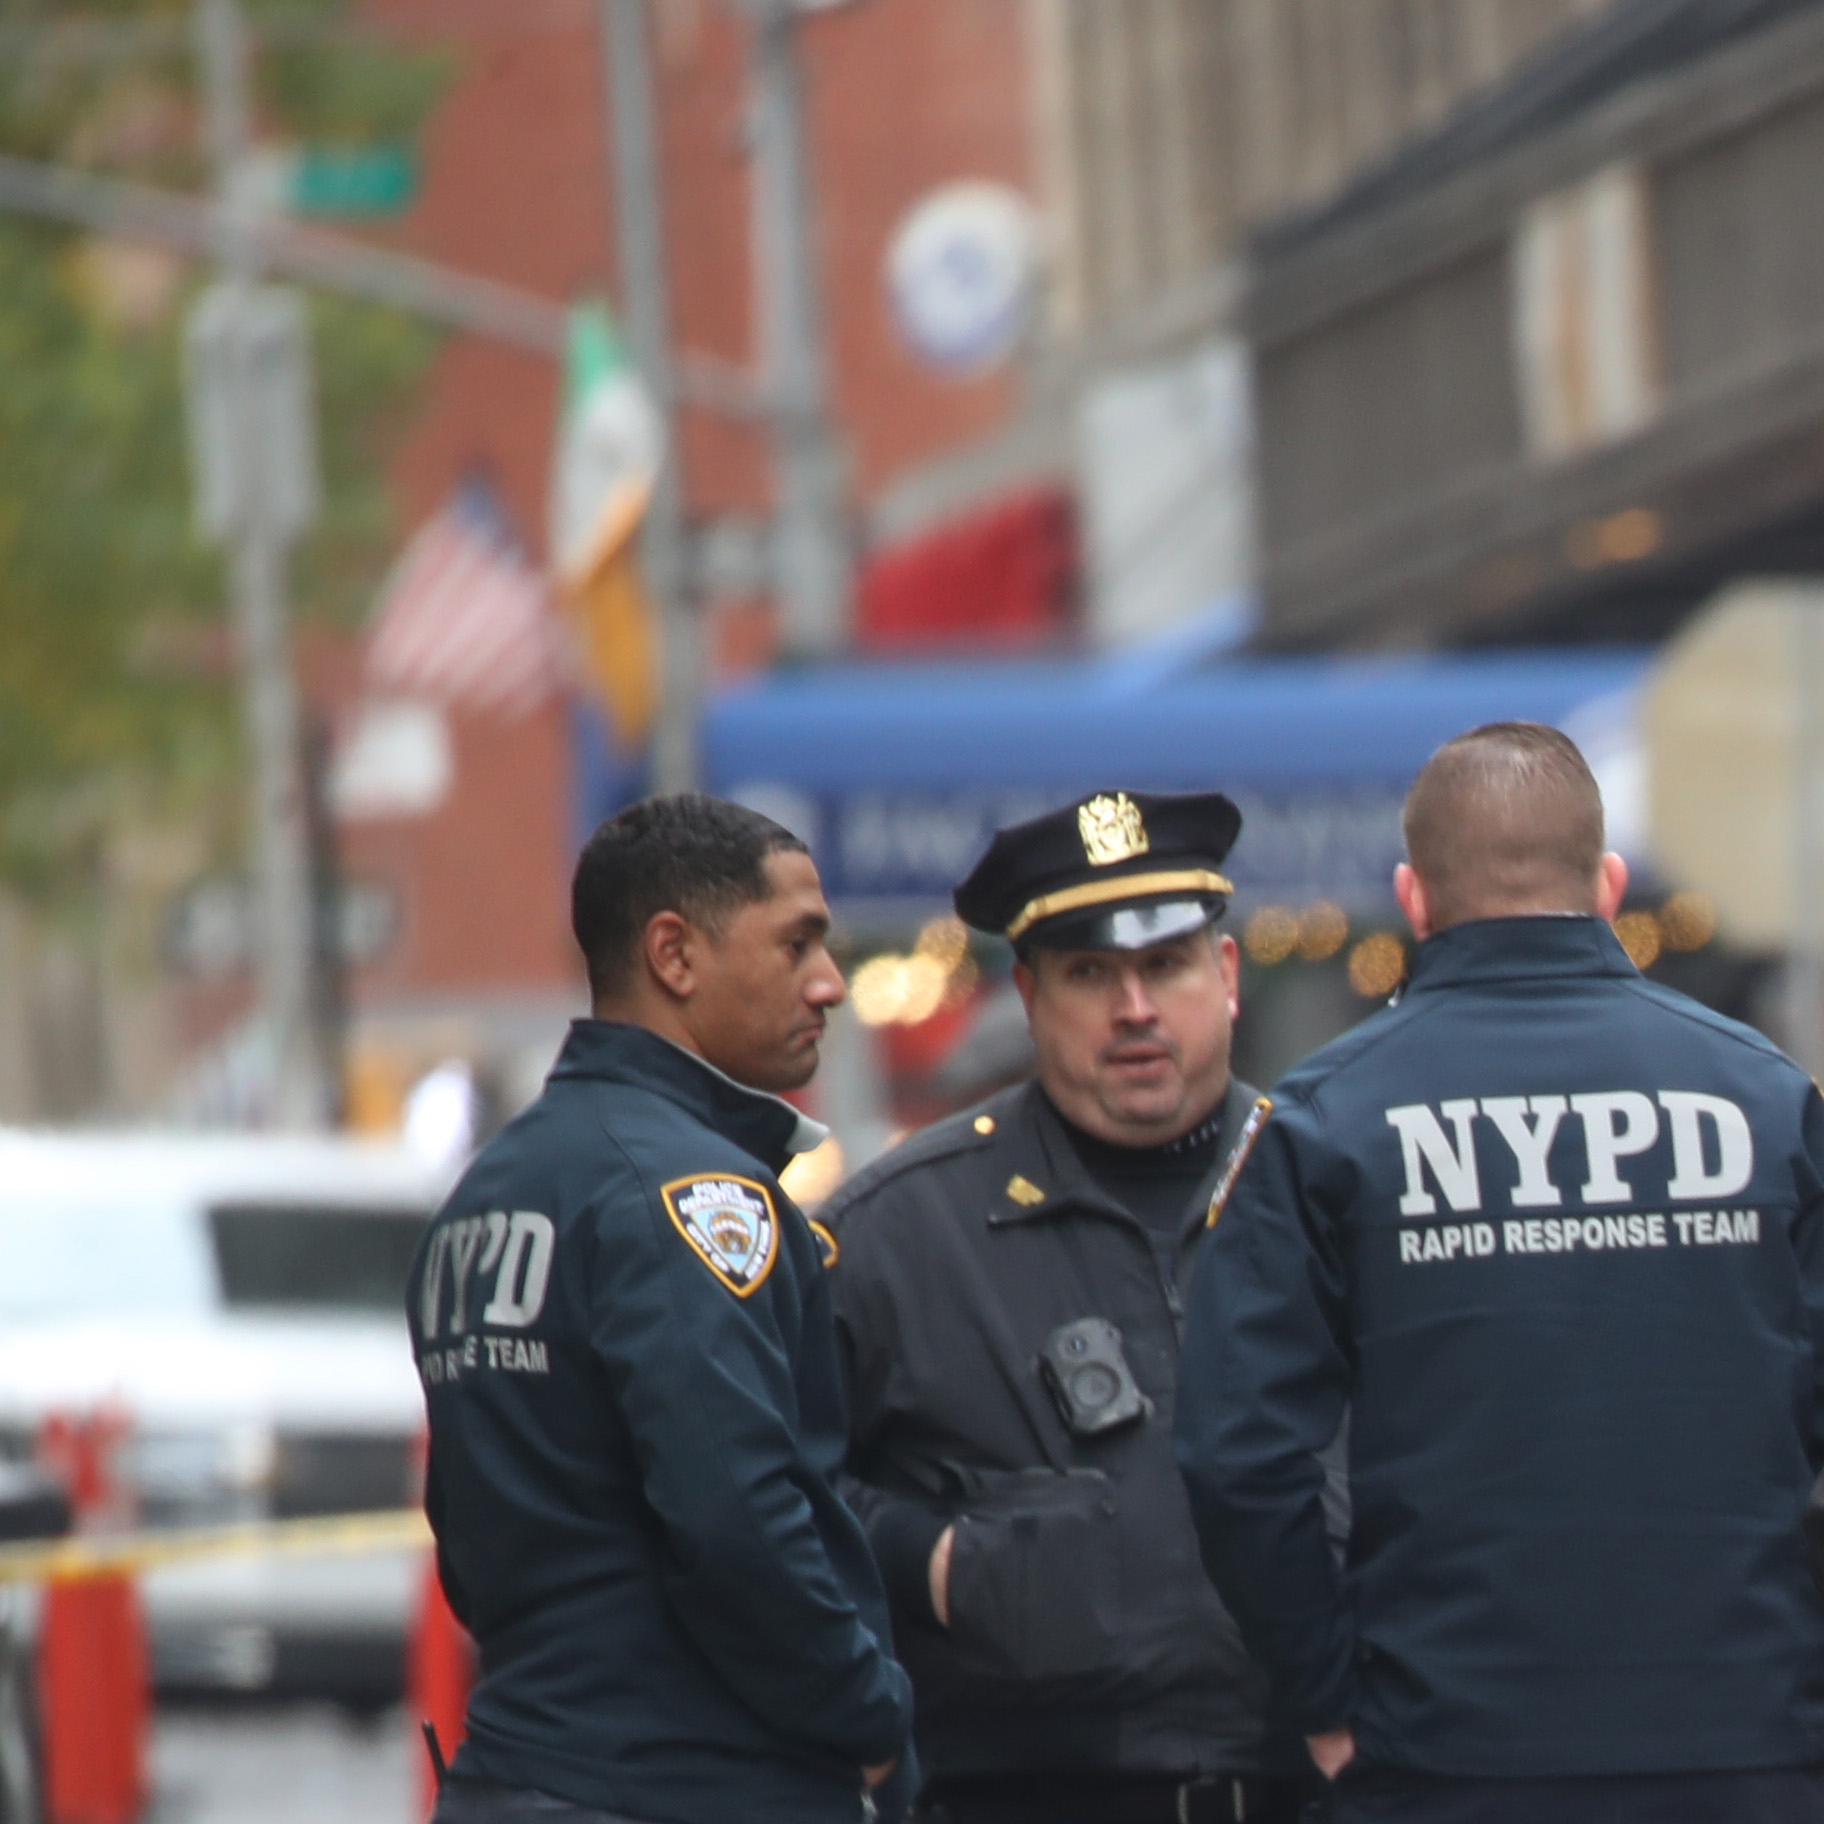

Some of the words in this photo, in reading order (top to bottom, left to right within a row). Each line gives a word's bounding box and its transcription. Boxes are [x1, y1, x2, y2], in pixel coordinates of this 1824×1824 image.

[1386, 1089, 1756, 1216] NYPD
[1400, 1223, 1497, 1263] RAPID
[1503, 1211, 1668, 1254] RESPONSE
[1672, 1210, 1760, 1245] TEAM
[483, 1334, 552, 1374] TEAM
